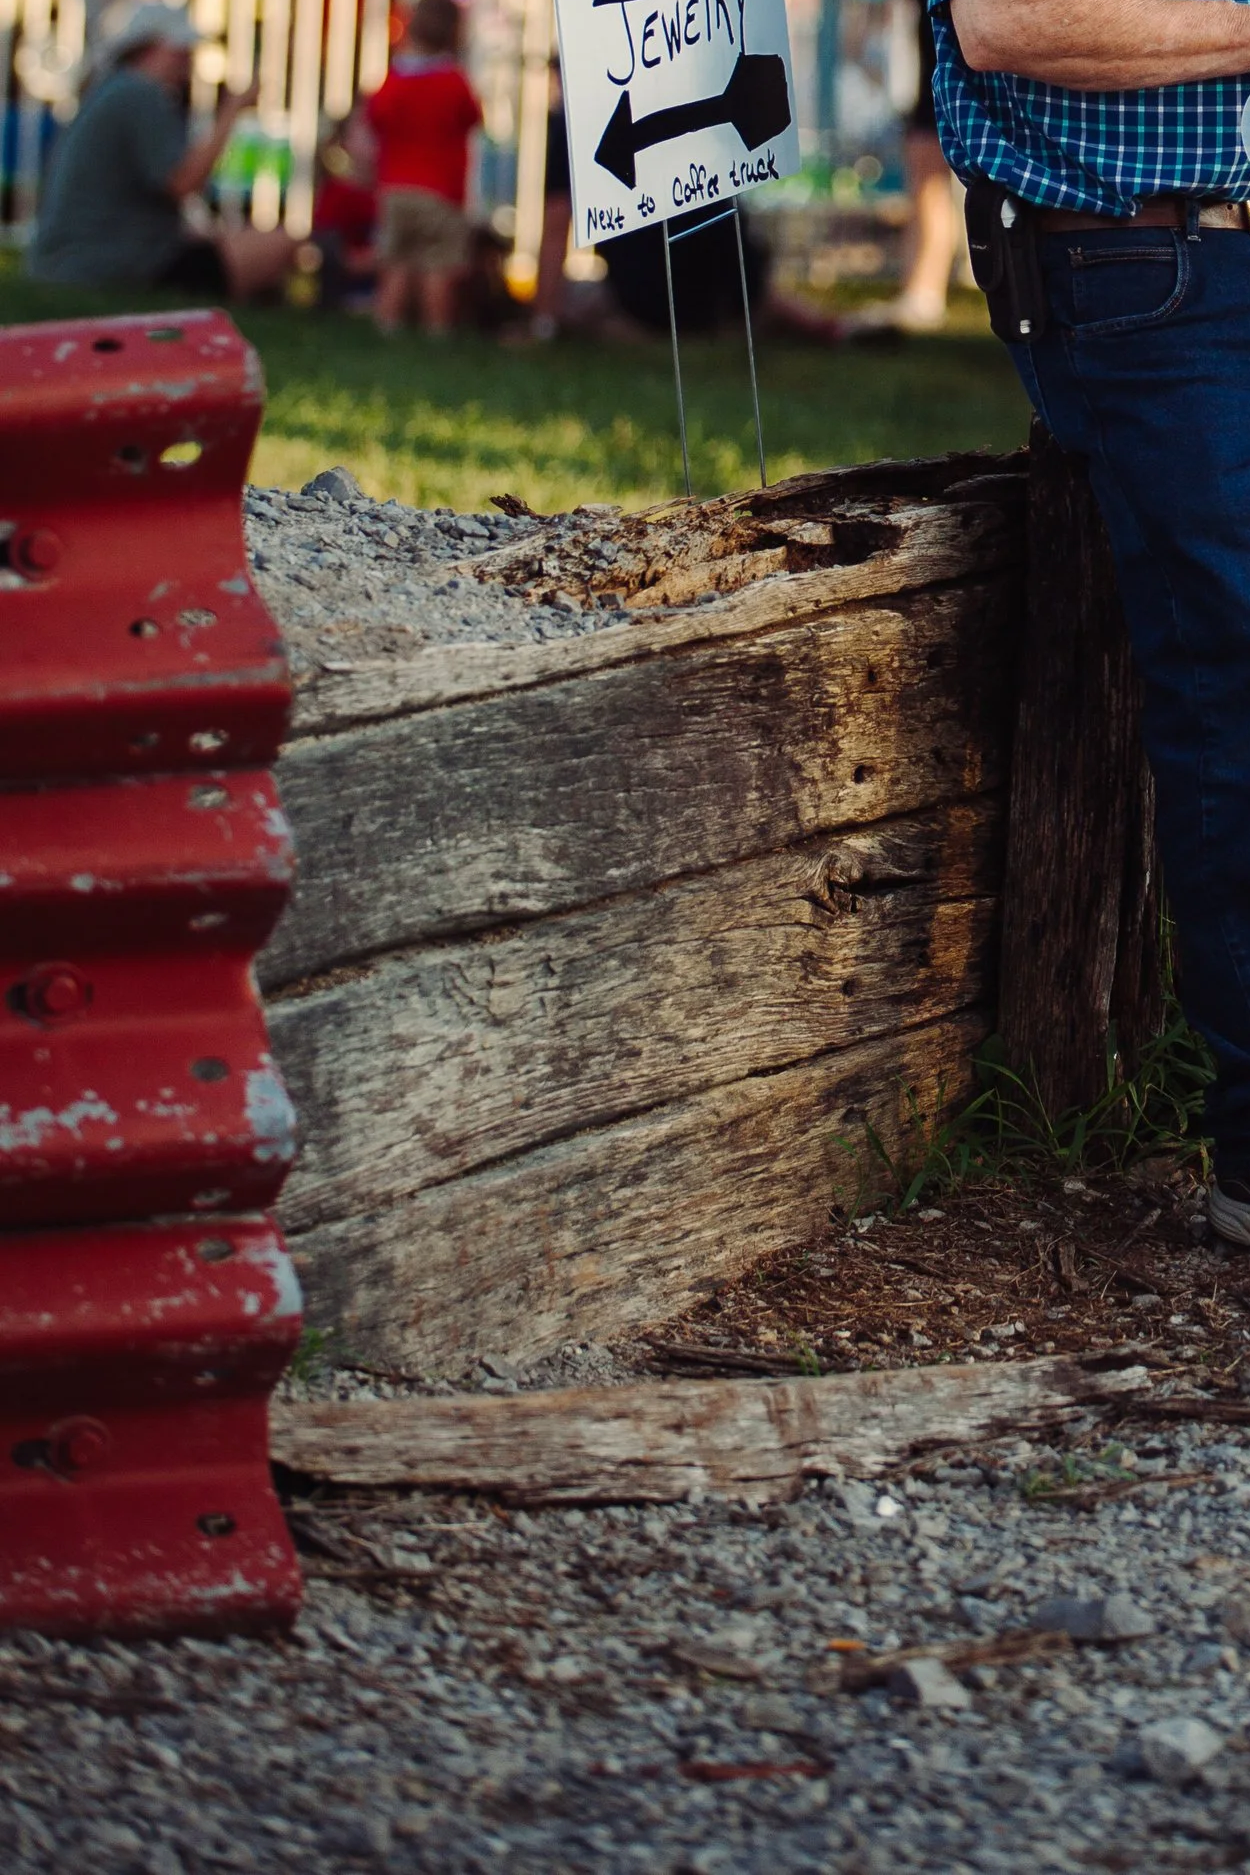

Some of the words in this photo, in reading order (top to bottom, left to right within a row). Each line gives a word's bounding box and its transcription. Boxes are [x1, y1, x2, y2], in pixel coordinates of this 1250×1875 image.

[587, 206, 625, 239] Next
[637, 193, 656, 217] to
[729, 148, 780, 188] truck
